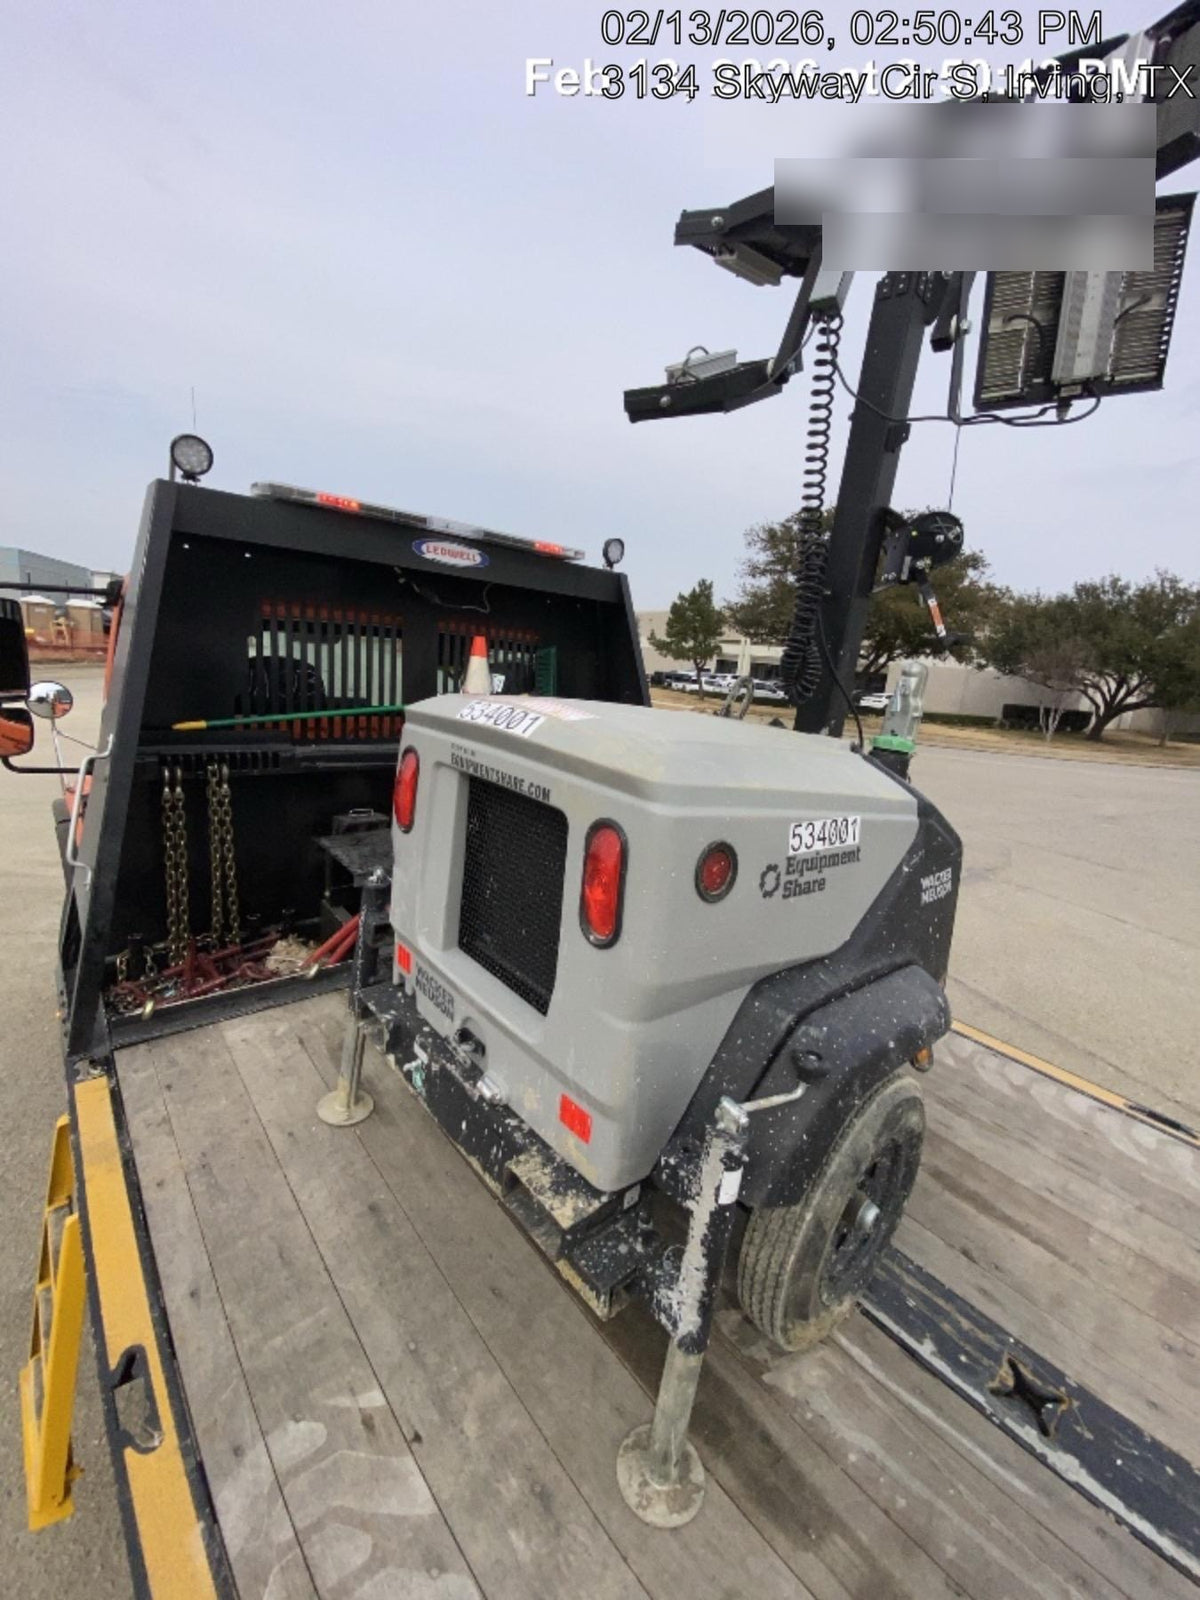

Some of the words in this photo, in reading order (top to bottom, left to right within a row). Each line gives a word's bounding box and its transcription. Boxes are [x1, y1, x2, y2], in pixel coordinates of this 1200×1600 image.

[459, 701, 541, 734] 534001
[790, 817, 857, 852] 534001
[785, 846, 861, 877] Equipment
[782, 877, 826, 899] Share
